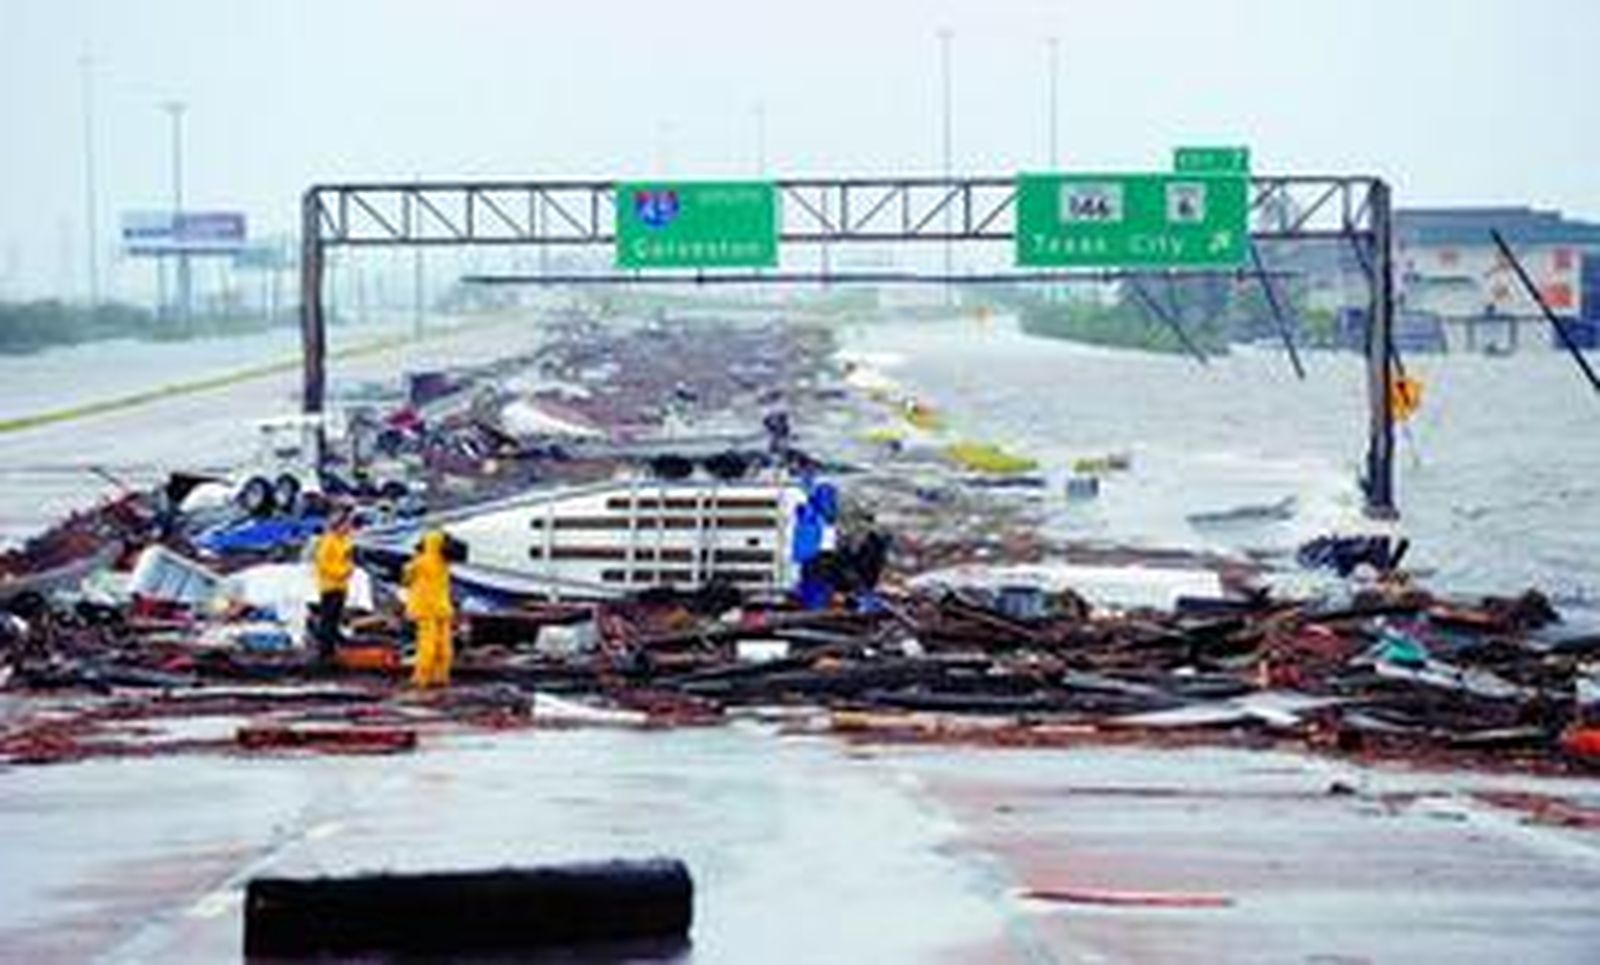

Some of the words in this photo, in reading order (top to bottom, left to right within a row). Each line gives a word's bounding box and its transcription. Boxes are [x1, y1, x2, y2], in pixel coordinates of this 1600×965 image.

[1069, 195, 1111, 217] 146
[1177, 195, 1194, 217] 6
[1033, 234, 1107, 254] Texas
[1129, 233, 1184, 254] City
